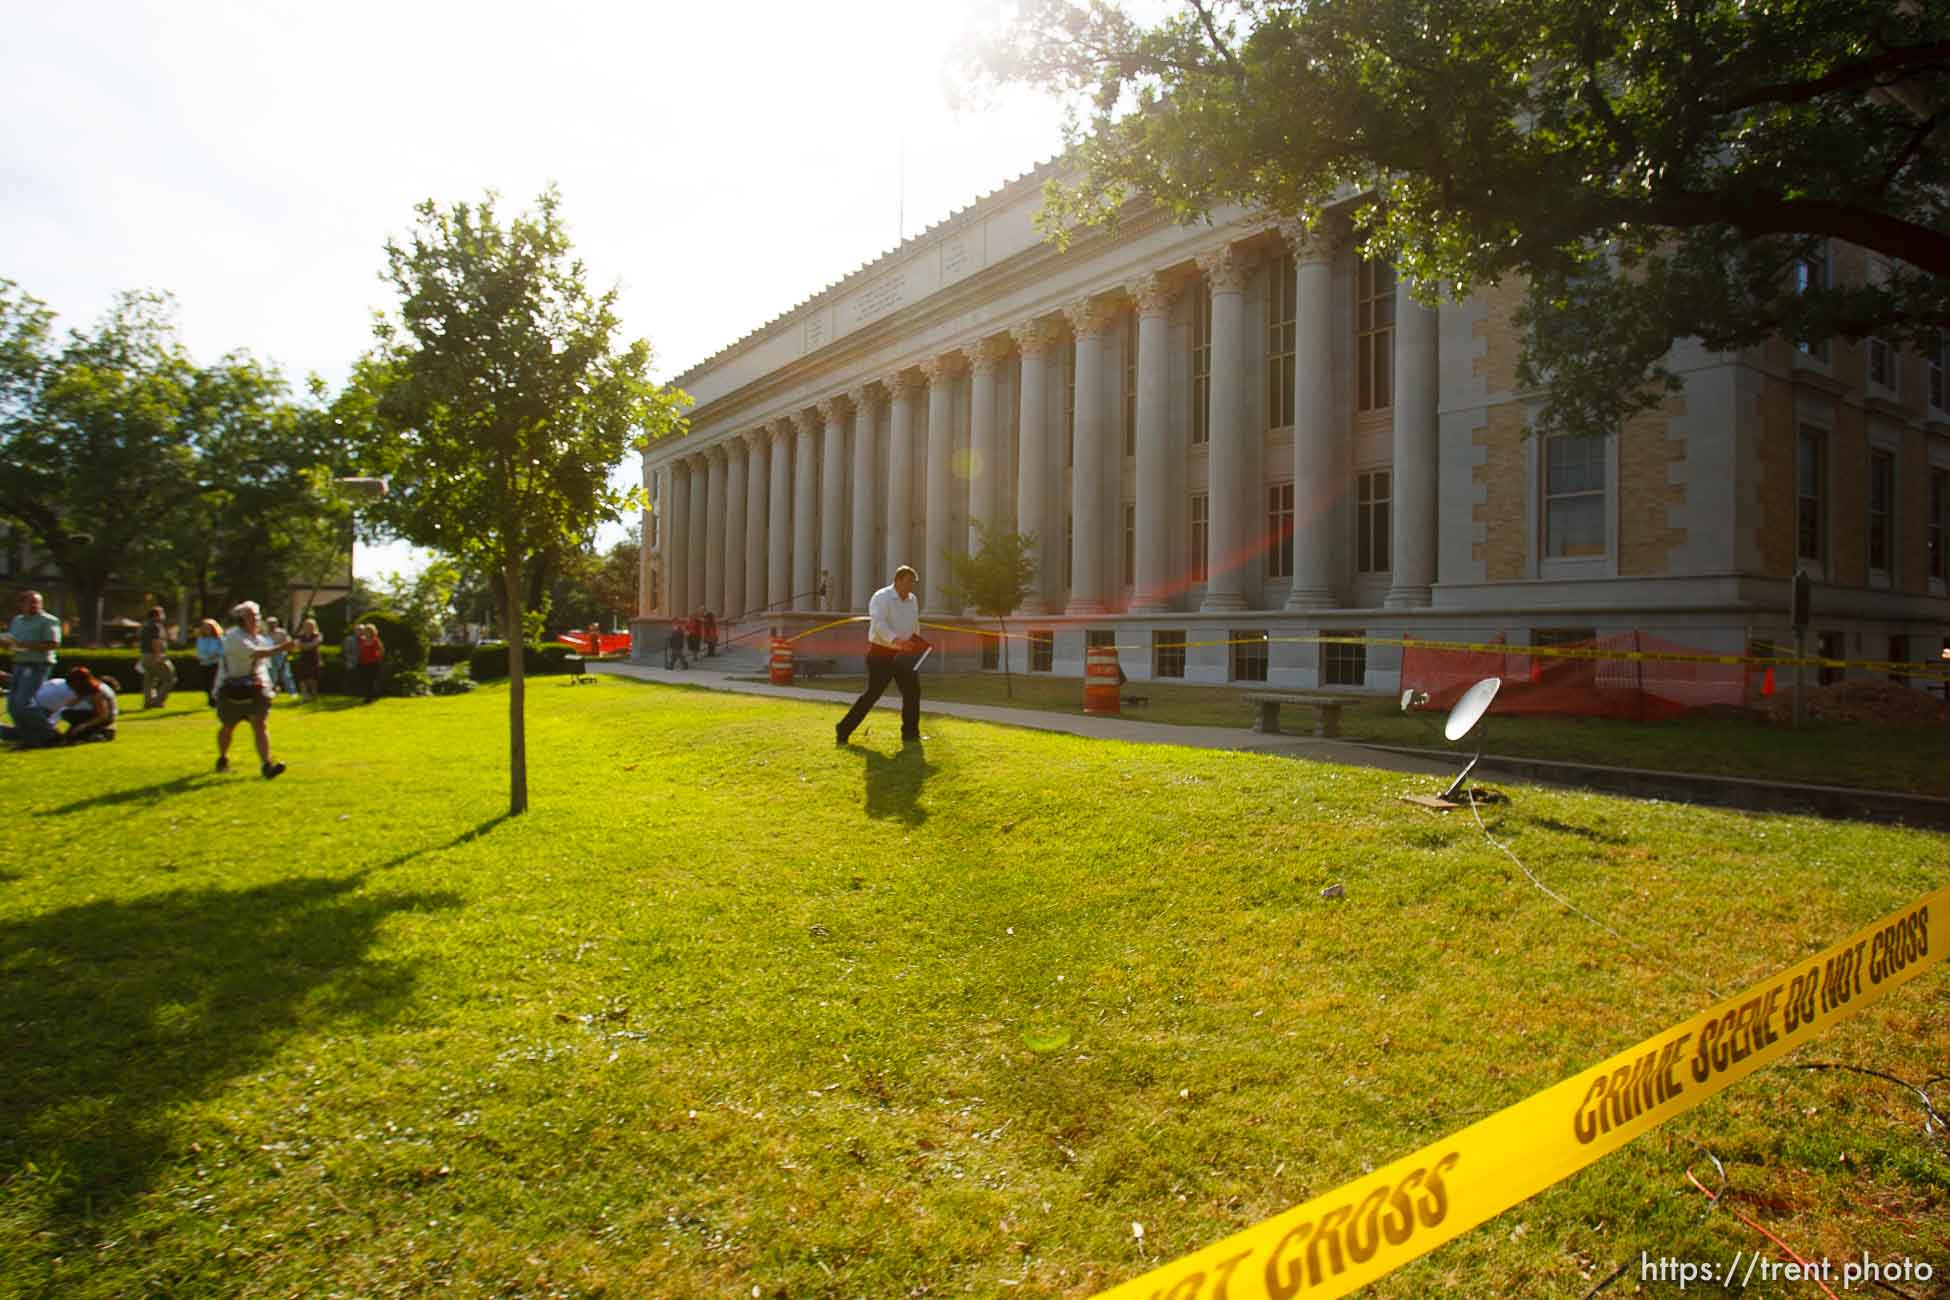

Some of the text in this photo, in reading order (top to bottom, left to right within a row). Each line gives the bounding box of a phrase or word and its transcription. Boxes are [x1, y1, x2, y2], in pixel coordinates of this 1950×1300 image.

[1574, 906, 1929, 1144] CRIME SCENE DO NOT CROSS
[1264, 1151, 1461, 1300] CROSS
